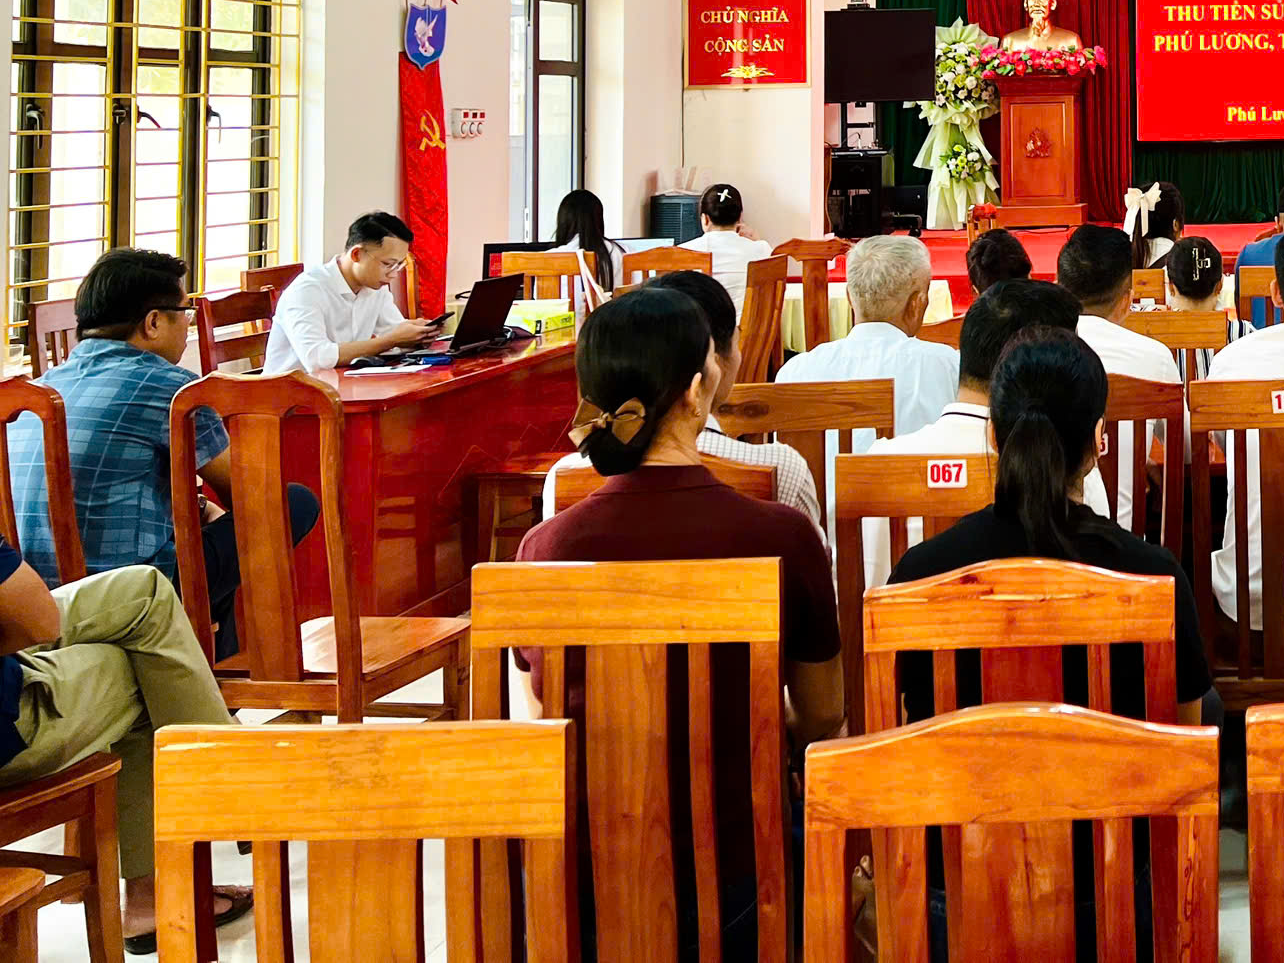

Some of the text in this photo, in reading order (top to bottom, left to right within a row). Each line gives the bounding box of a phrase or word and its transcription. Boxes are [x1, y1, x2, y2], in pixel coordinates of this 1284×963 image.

[701, 6, 789, 23] CHỦ NGHĨA
[1163, 5, 1205, 21] THU
[704, 34, 784, 56] CỘNG SẢN
[1154, 30, 1193, 51] PHÚ
[1199, 32, 1274, 51] LƯƠNG,
[1227, 106, 1257, 122] Phú
[930, 463, 963, 483] 067
